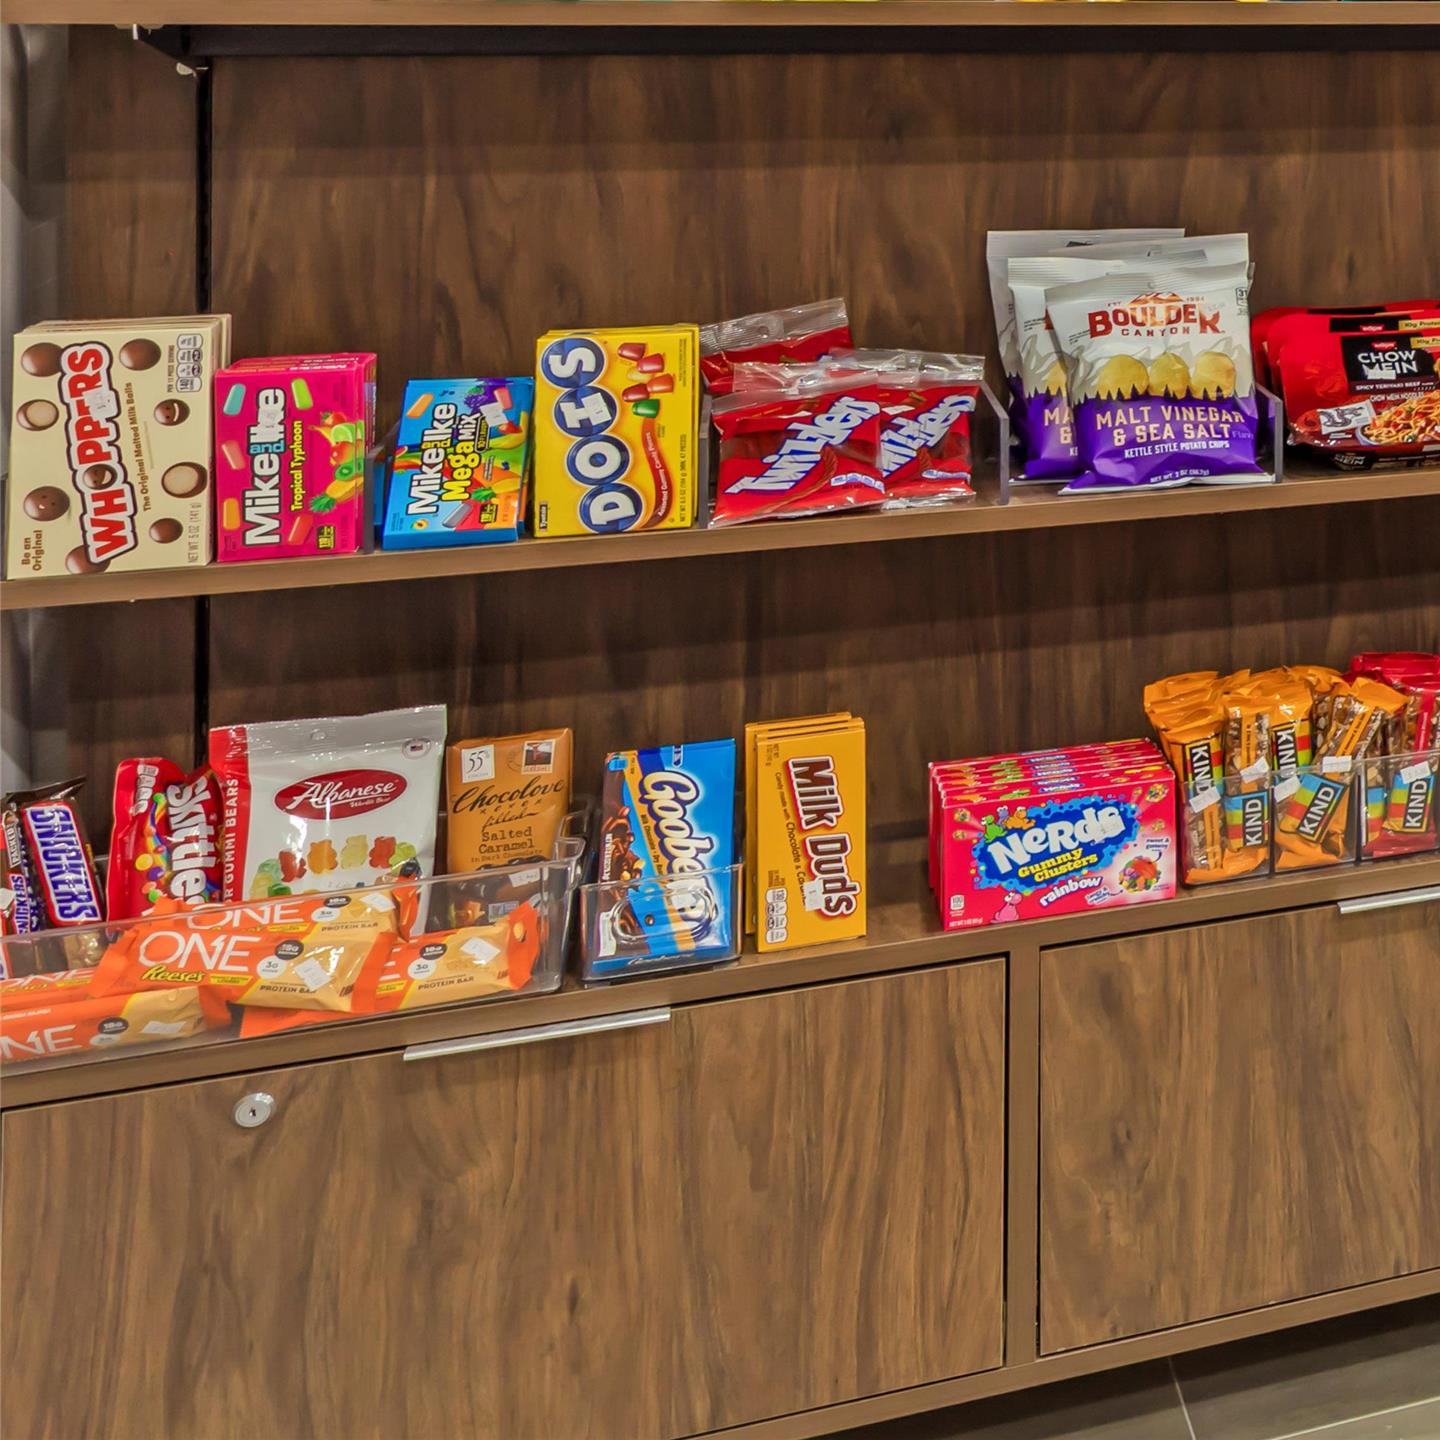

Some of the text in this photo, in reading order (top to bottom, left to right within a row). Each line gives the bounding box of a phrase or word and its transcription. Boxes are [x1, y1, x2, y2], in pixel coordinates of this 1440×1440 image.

[1088, 304, 1221, 338] BOULDER
[1121, 327, 1190, 336] CANYON
[1358, 350, 1417, 363] CHOW
[1097, 407, 1245, 430] MALT VINEGAR
[290, 421, 303, 511] Tropical Typhoon
[289, 779, 399, 809] Albanese
[1405, 778, 1427, 828] KIND
[225, 779, 239, 885] GUMMI BEARS
[481, 827, 532, 841] Salted
[792, 758, 859, 914] Milk Duds
[1244, 797, 1263, 846] KIND
[479, 840, 534, 855] Caramel
[1018, 848, 1082, 877] Gummy
[1034, 853, 1098, 882] Clusters
[1040, 876, 1103, 906] rainbow
[139, 930, 260, 971] ONE
